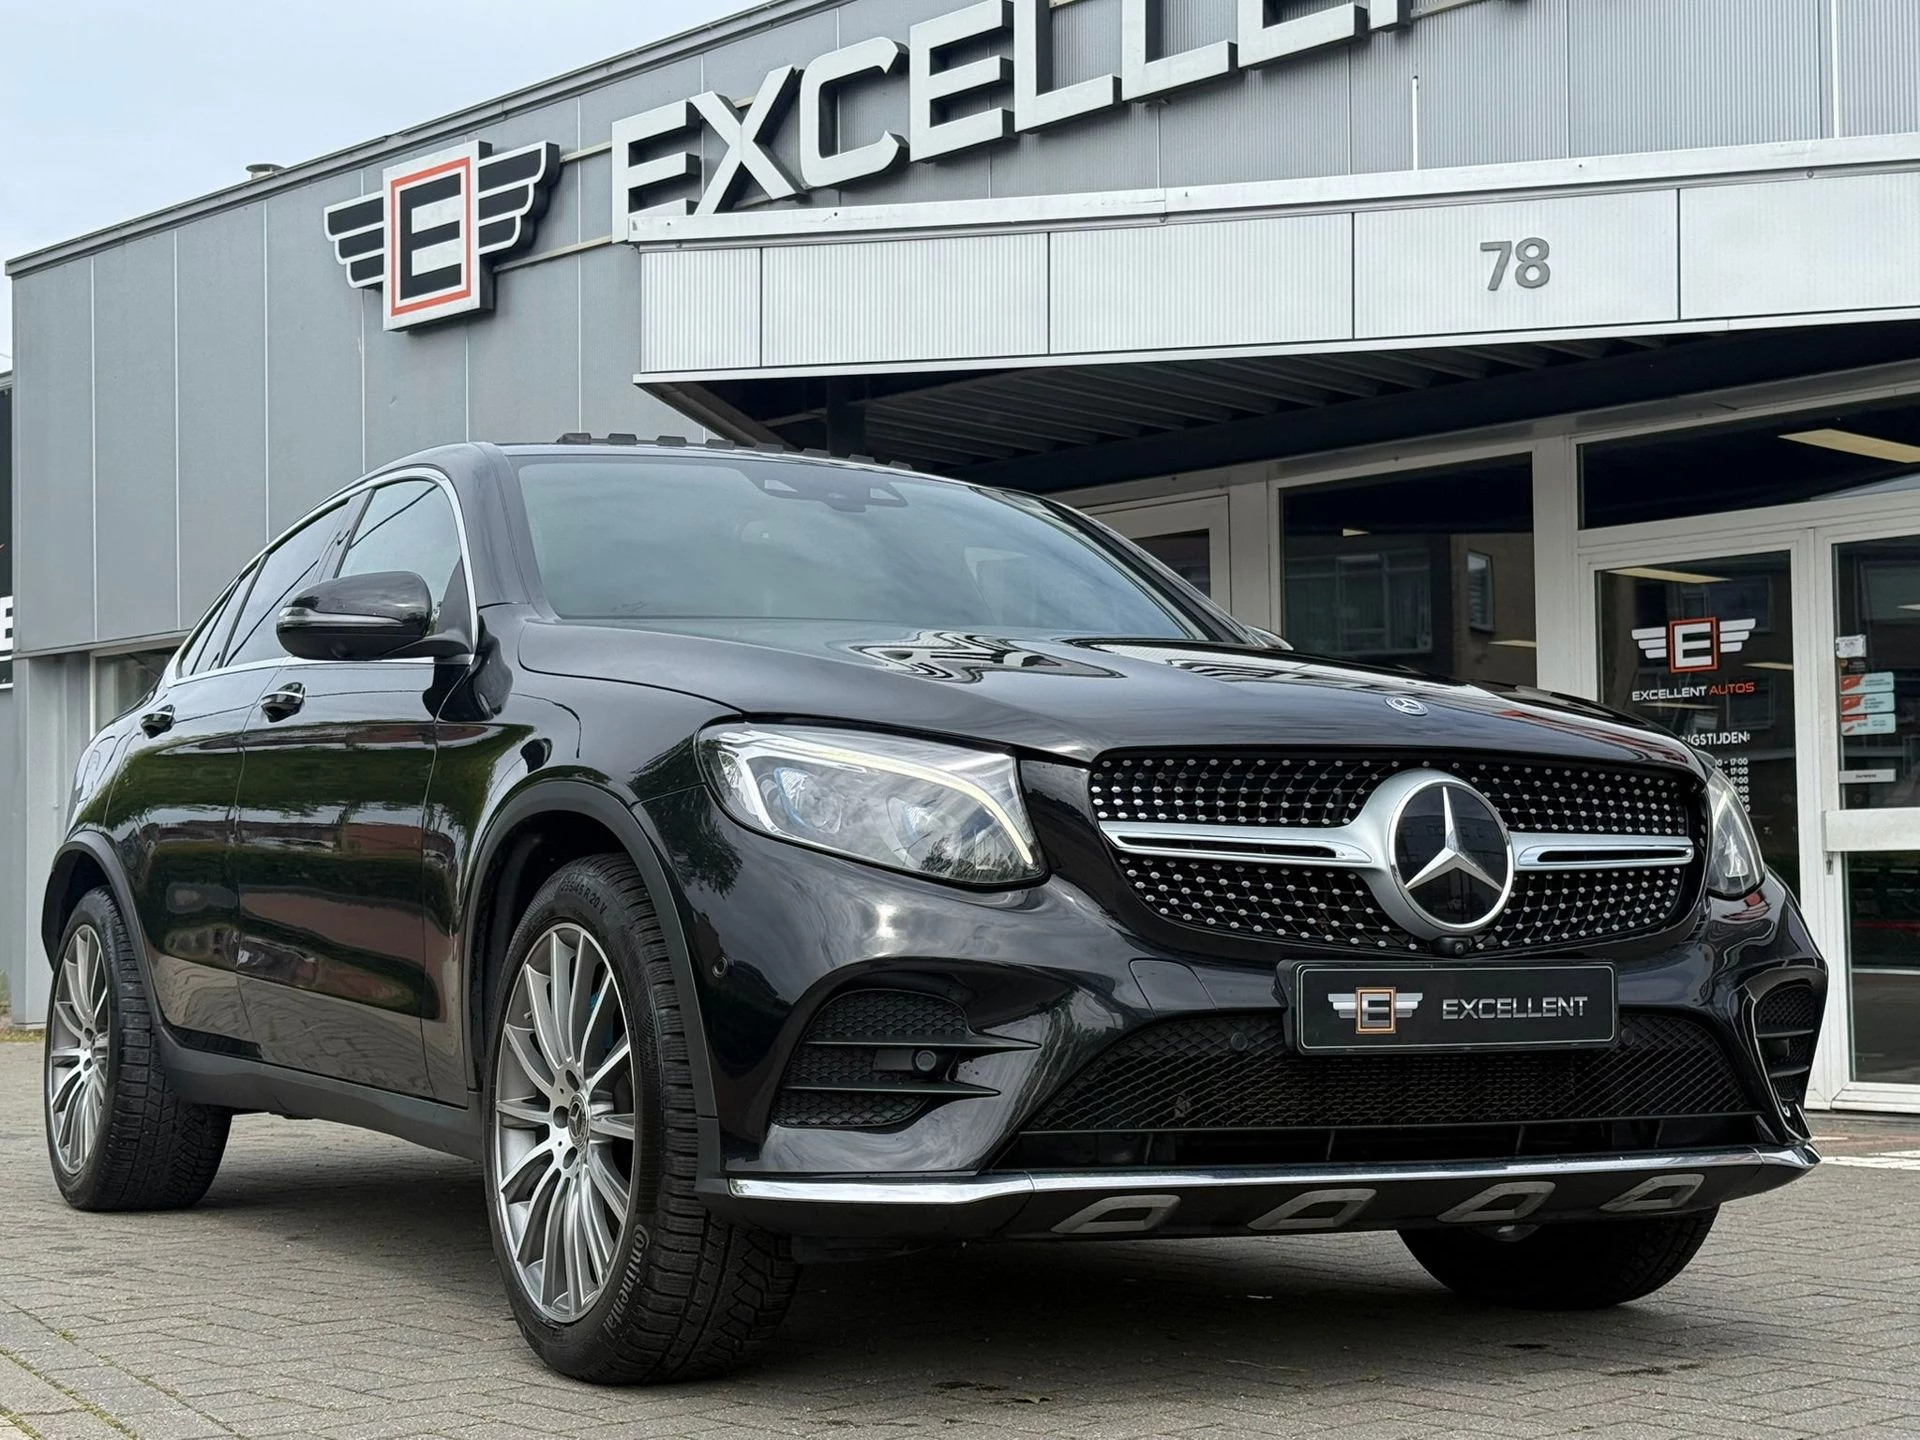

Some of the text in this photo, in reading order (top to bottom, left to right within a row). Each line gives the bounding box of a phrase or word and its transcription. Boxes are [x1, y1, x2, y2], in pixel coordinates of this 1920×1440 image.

[400, 172, 462, 301] E
[1480, 237, 1551, 291] 78
[1673, 621, 1713, 669] E
[1632, 682, 1755, 701] EXCELLENT AUTOS
[1361, 993, 1390, 1027] E
[1442, 996, 1588, 1020] EXCELLENT
[602, 1224, 650, 1340] Continental
